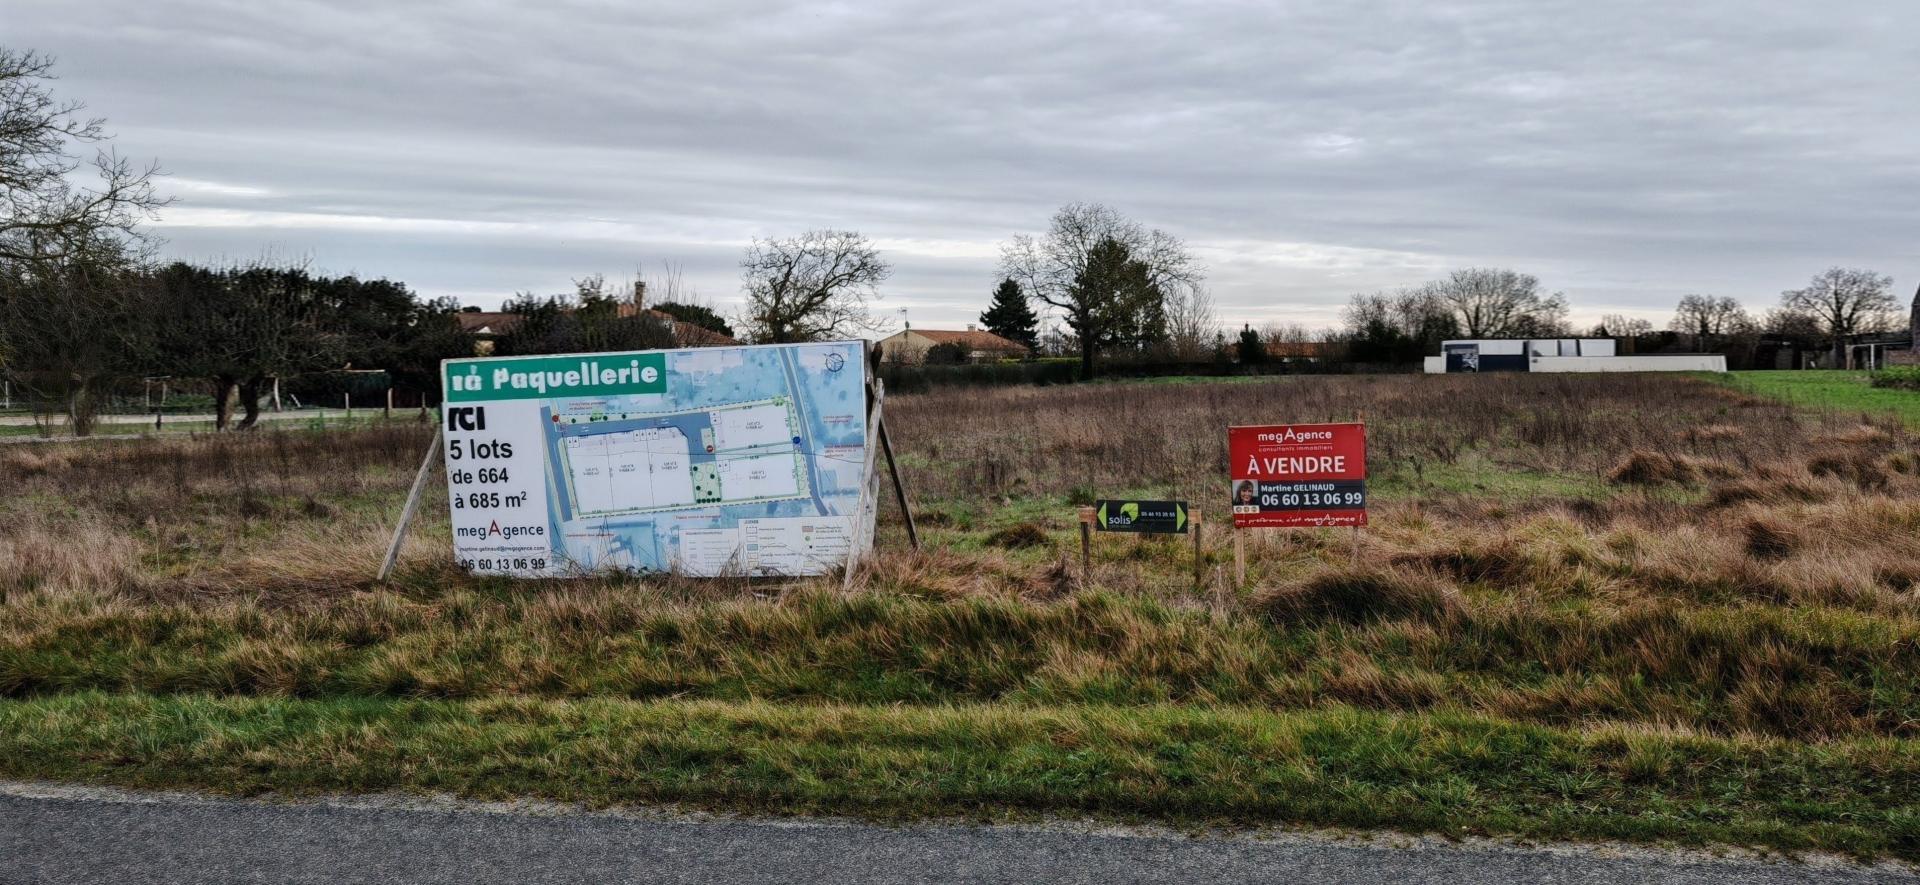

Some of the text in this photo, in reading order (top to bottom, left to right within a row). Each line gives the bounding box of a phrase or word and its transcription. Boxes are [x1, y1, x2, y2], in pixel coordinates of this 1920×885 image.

[493, 360, 658, 393] Paquellerie
[1258, 427, 1332, 443] megAgence
[450, 439, 513, 460] 5 lots
[1247, 455, 1346, 475] À VENDRE
[452, 468, 509, 484] de 664
[1261, 483, 1335, 492] Martine GELINAUD
[455, 493, 464, 509] à
[469, 493, 500, 508] 685
[1261, 492, 1362, 506] 06 60 13 06 99
[1304, 514, 1355, 526] megAgence
[457, 519, 544, 540] megAgence
[461, 558, 545, 570] 06 60 13 06 99
